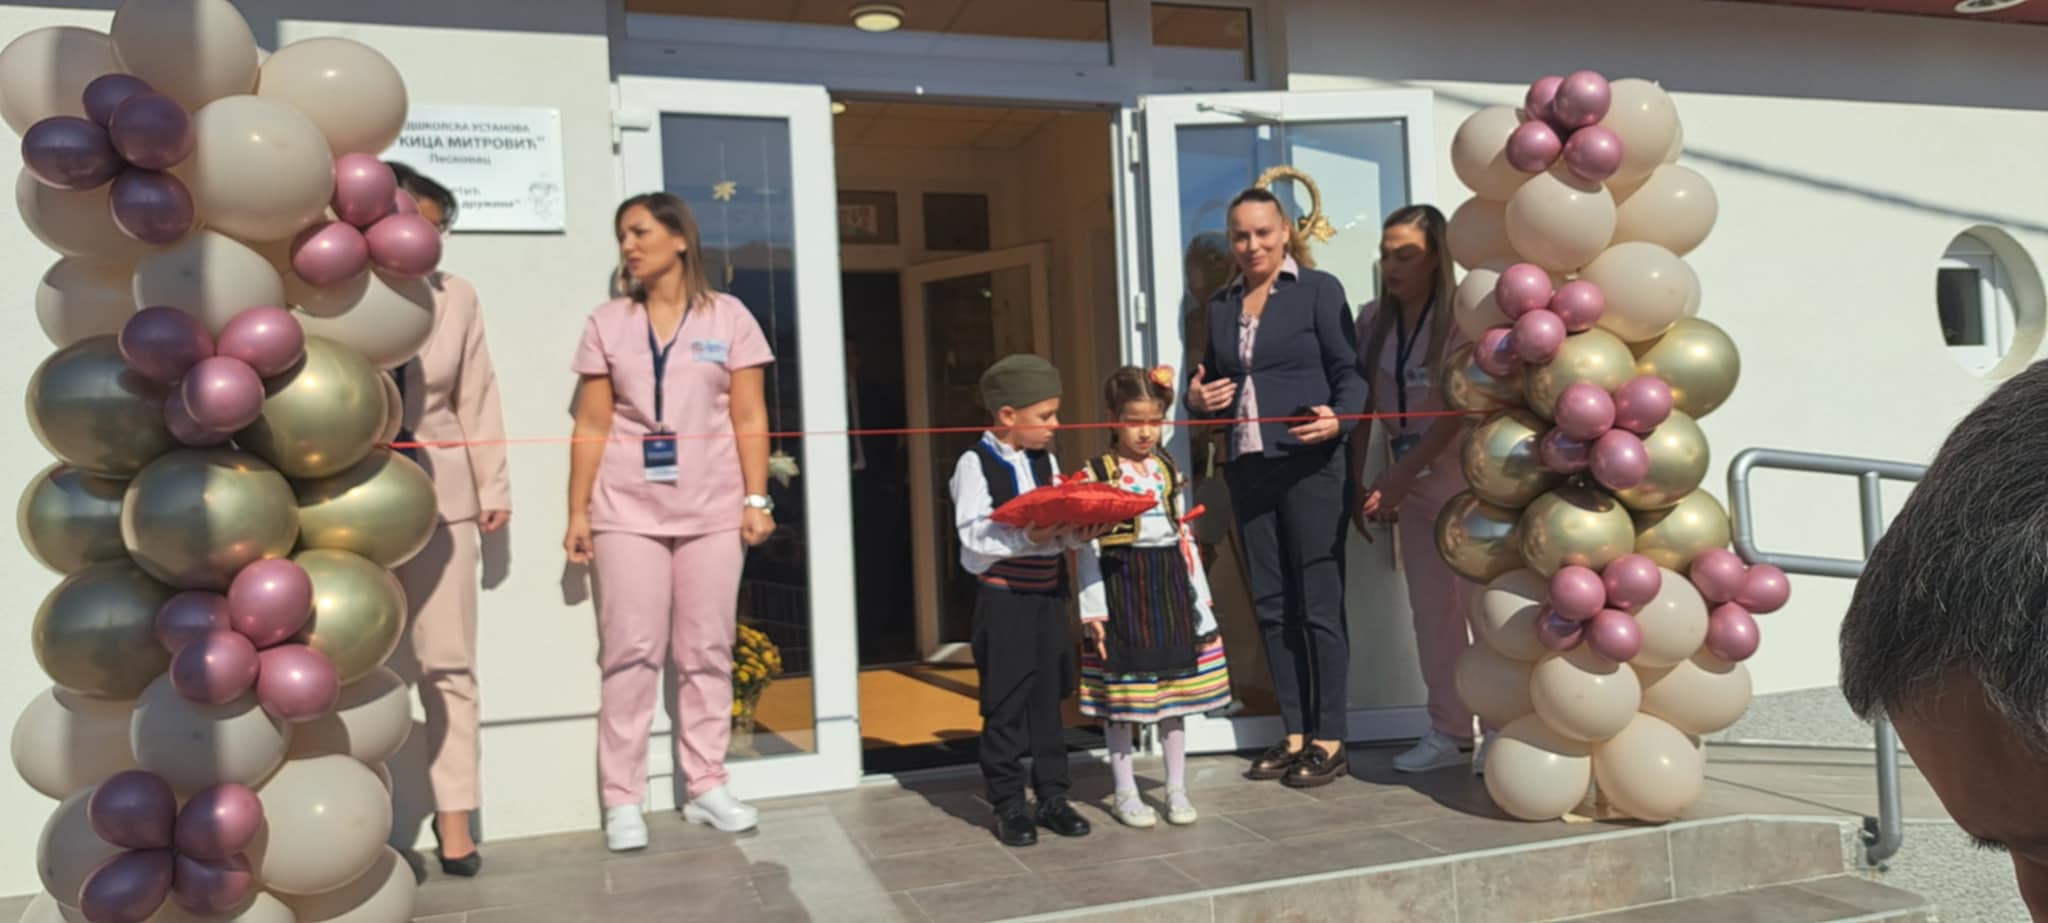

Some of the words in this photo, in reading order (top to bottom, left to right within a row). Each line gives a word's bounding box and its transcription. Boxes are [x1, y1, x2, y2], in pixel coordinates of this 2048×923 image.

[406, 121, 468, 133] ДШКОЛСКА
[472, 122, 530, 134] УСТАНОВА
[400, 136, 444, 151] КИЦА
